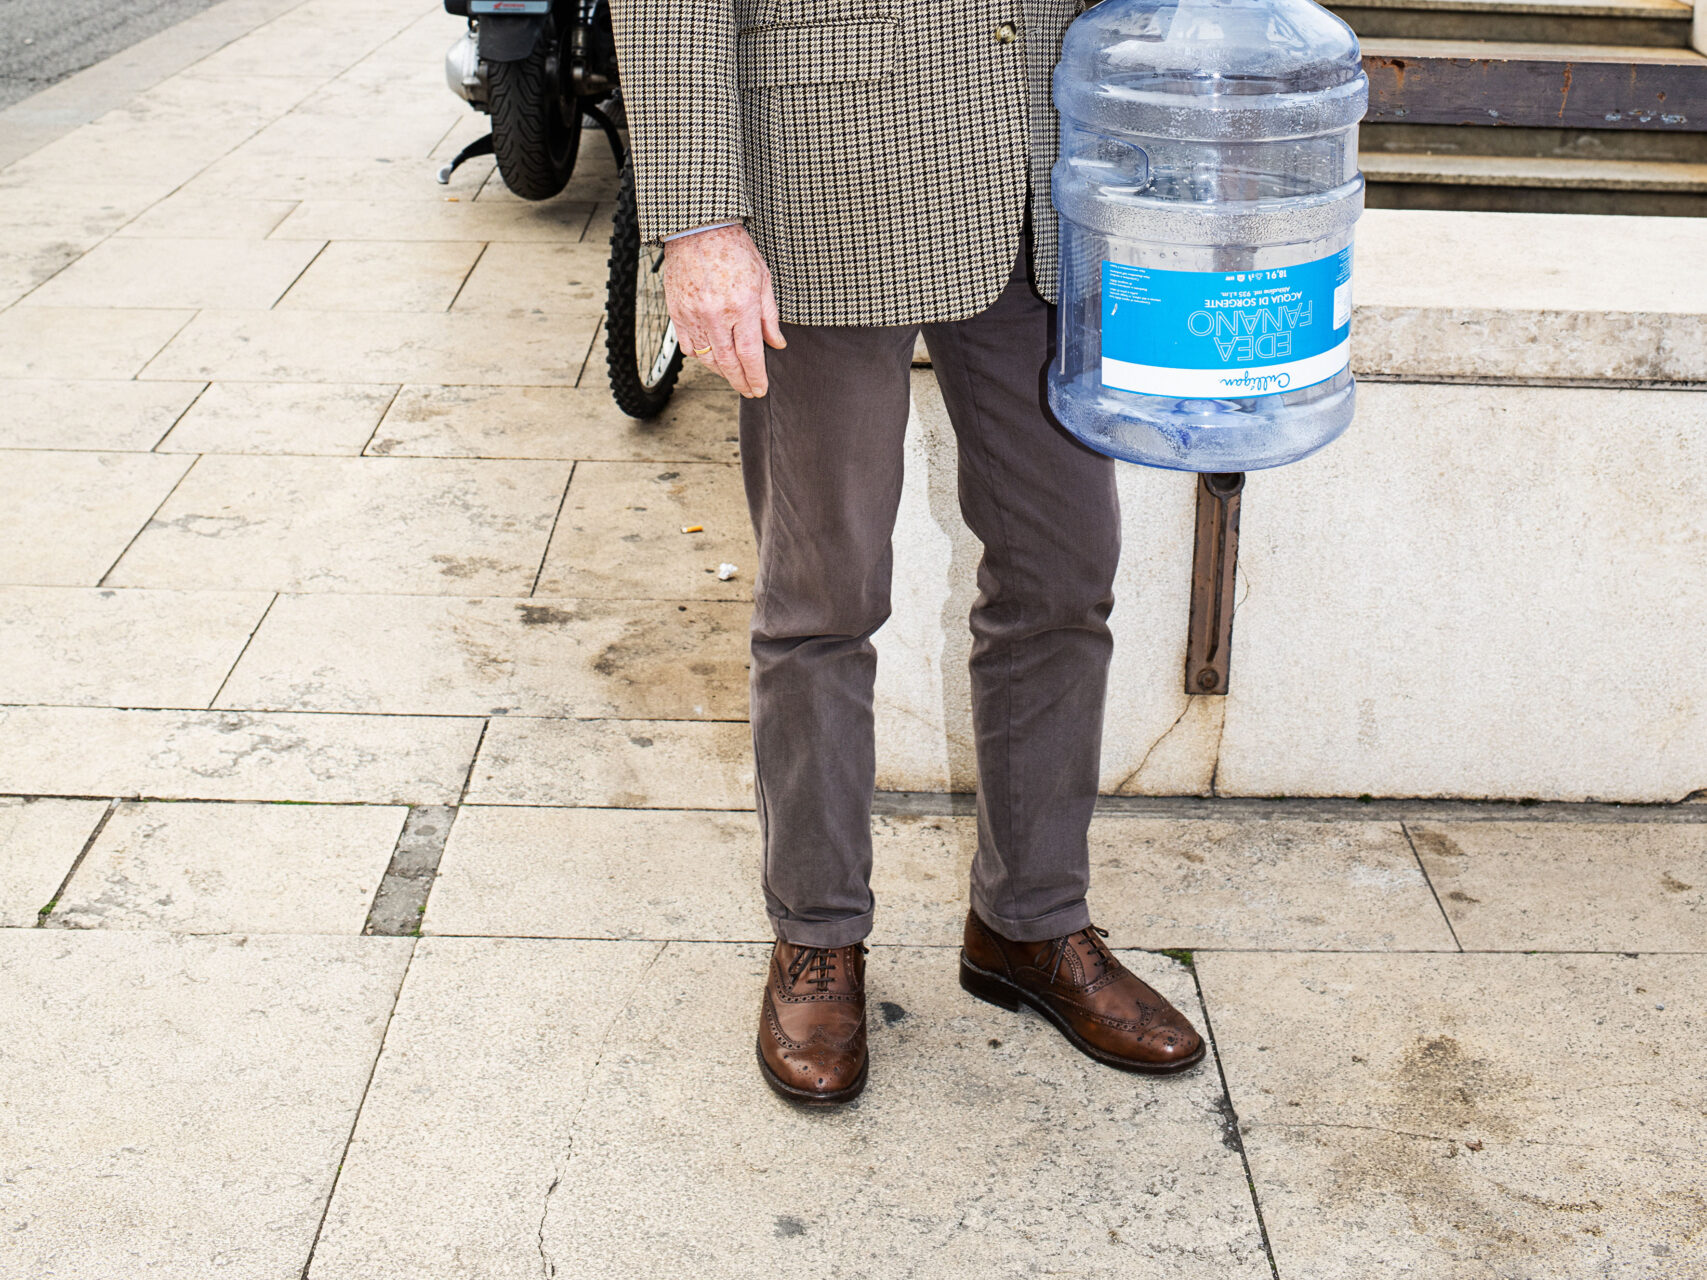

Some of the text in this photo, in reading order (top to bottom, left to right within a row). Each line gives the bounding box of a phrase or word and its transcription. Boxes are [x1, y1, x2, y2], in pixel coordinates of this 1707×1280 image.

[1271, 269, 1287, 280] 18,9
[1204, 291, 1302, 308] ACQUA DI SORGENTE
[1187, 300, 1312, 337] FANANO
[1213, 331, 1292, 362] EDEA
[1219, 370, 1291, 391] Culligan
